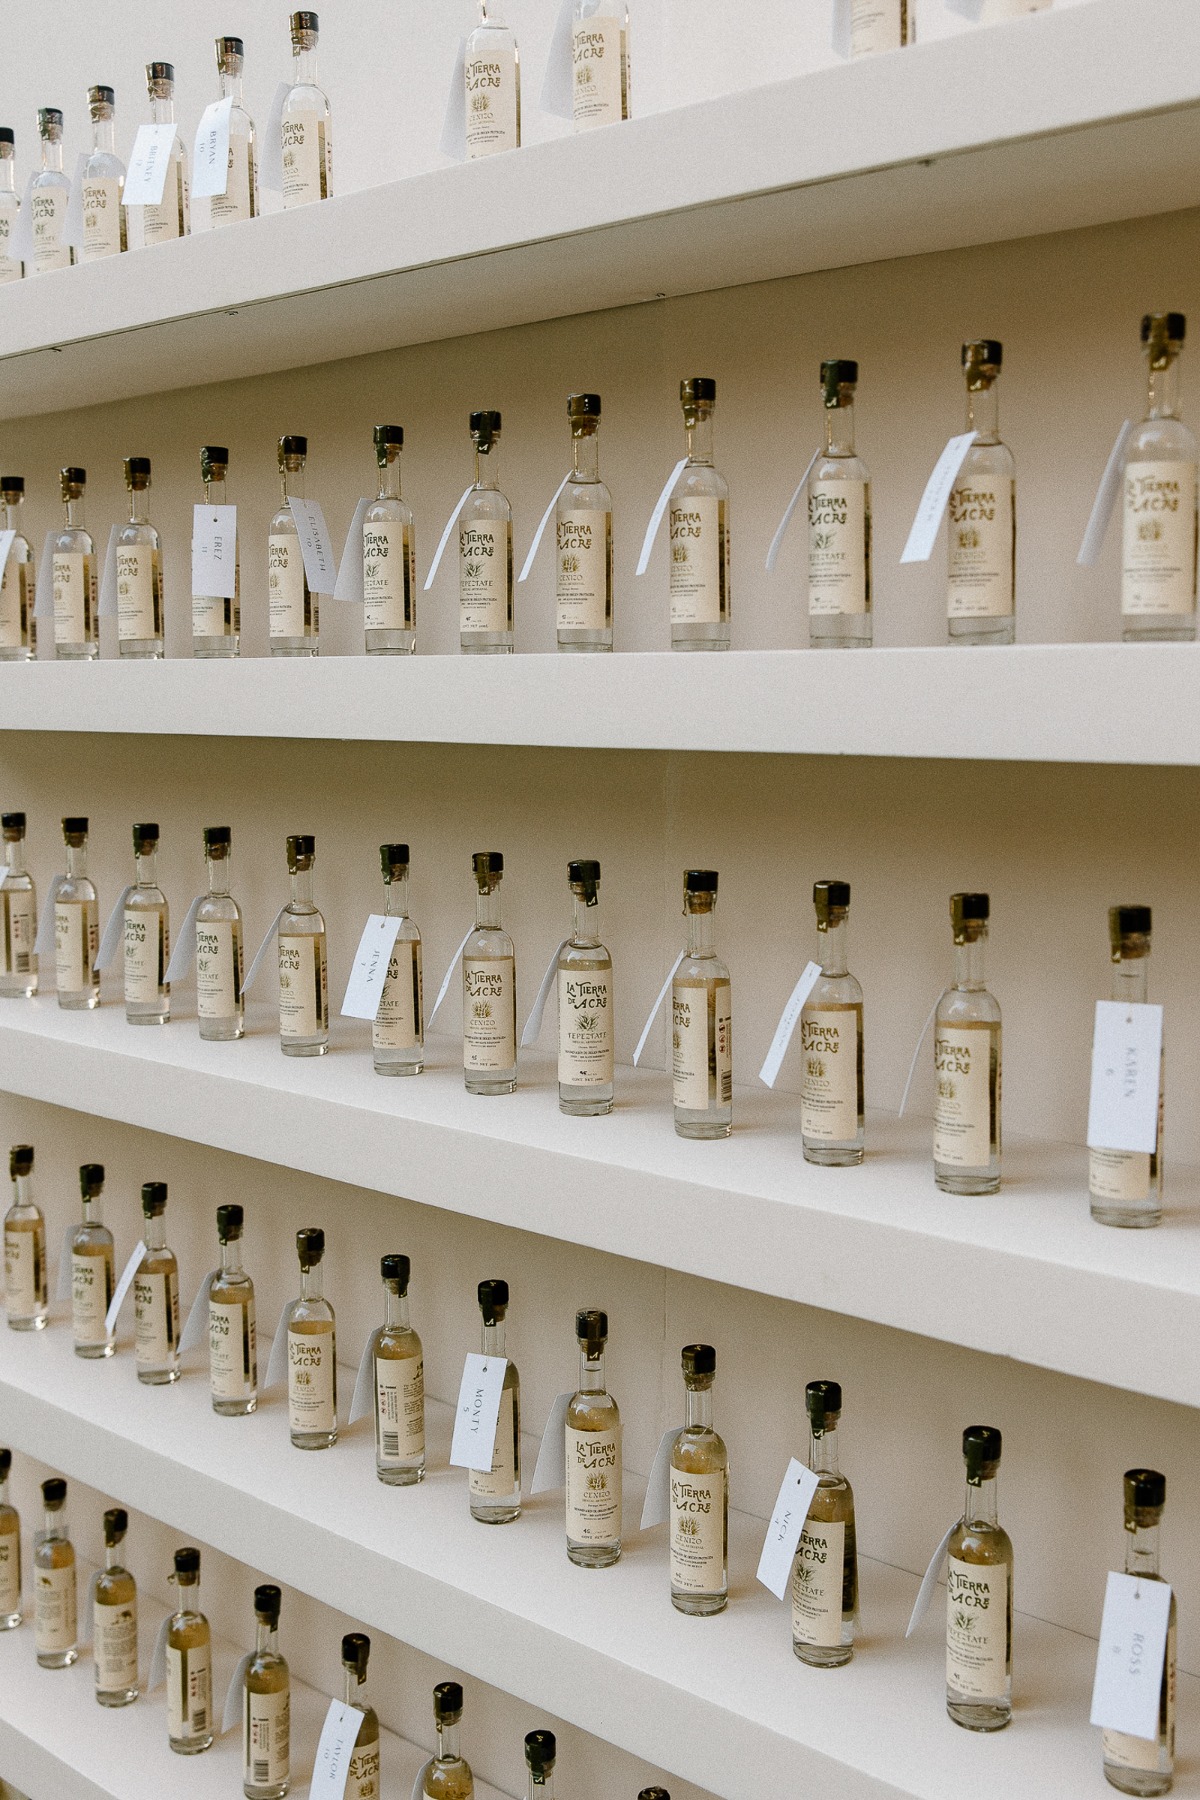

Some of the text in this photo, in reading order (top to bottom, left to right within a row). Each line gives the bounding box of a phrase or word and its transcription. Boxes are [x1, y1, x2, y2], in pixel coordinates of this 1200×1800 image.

[574, 47, 604, 64] ACRE
[470, 60, 501, 77] TIERRA
[469, 78, 501, 91] ACRE
[208, 131, 217, 165] BRYAN
[671, 509, 702, 526] TIERRA
[811, 512, 848, 526] ACRE
[954, 509, 995, 523] ACRE
[561, 521, 592, 537] TIERRA
[670, 527, 702, 540] ACRE
[308, 515, 326, 572] ELISABETH
[464, 530, 495, 547] TIERRA
[560, 538, 592, 550] ACRE
[213, 536, 223, 561] EREZ
[364, 547, 389, 559] ACRE
[463, 547, 495, 558] ACRE
[366, 950, 380, 983] JENNA
[471, 970, 503, 986] TIERRA
[470, 986, 503, 997] ACRE
[566, 981, 608, 998] LA TIERRA
[574, 997, 608, 1010] ACRE
[568, 1032, 607, 1040] TEPEZTATE
[805, 1020, 839, 1041] TIERRA
[804, 1041, 839, 1054] ACRE
[294, 1343, 321, 1357] TIERRA
[293, 1357, 321, 1367] ACRE
[470, 1388, 484, 1434] MONTY
[576, 1441, 616, 1457] LA TIERRA
[583, 1454, 616, 1469] ACRE
[583, 1490, 611, 1499] CENIZO
[677, 1481, 712, 1502] TIERRA
[676, 1501, 712, 1514] ACRE
[777, 1510, 792, 1541] NICK
[675, 1533, 703, 1545] CENIZO
[953, 1570, 990, 1596] TIERRA
[952, 1593, 990, 1610] ACRE
[1129, 1633, 1145, 1674] ROSS
[329, 1738, 344, 1780] TAYLOR
